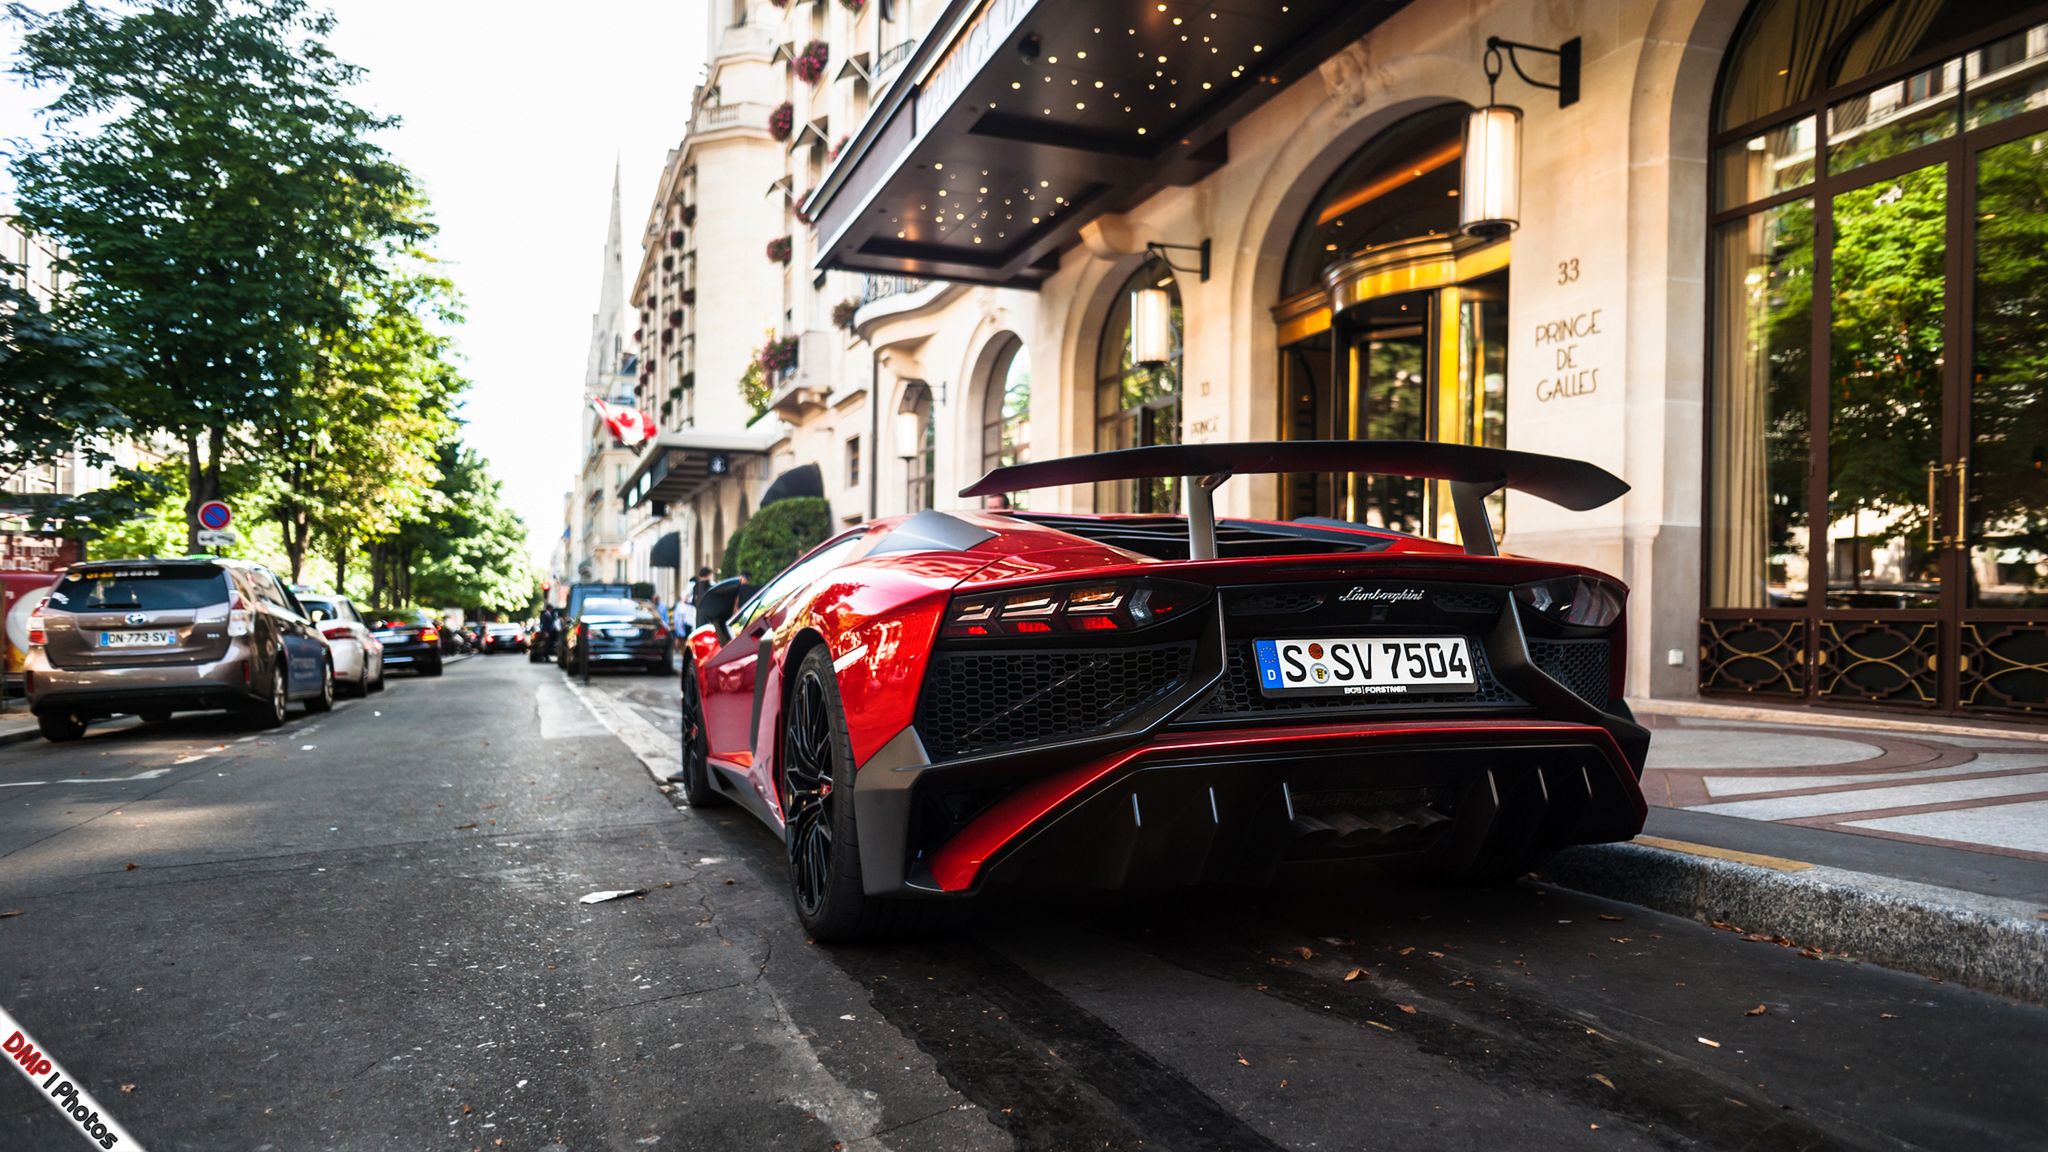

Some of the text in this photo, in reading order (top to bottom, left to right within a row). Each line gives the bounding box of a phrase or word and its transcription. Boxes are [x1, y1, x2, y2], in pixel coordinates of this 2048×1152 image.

[1558, 258, 1580, 285] 33
[1535, 309, 1602, 347] PRINCE
[1556, 345, 1578, 370] DE
[1536, 368, 1599, 402] GALLES
[1338, 586, 1425, 604] Lamborghini
[1267, 642, 1468, 682] D S SV 7504
